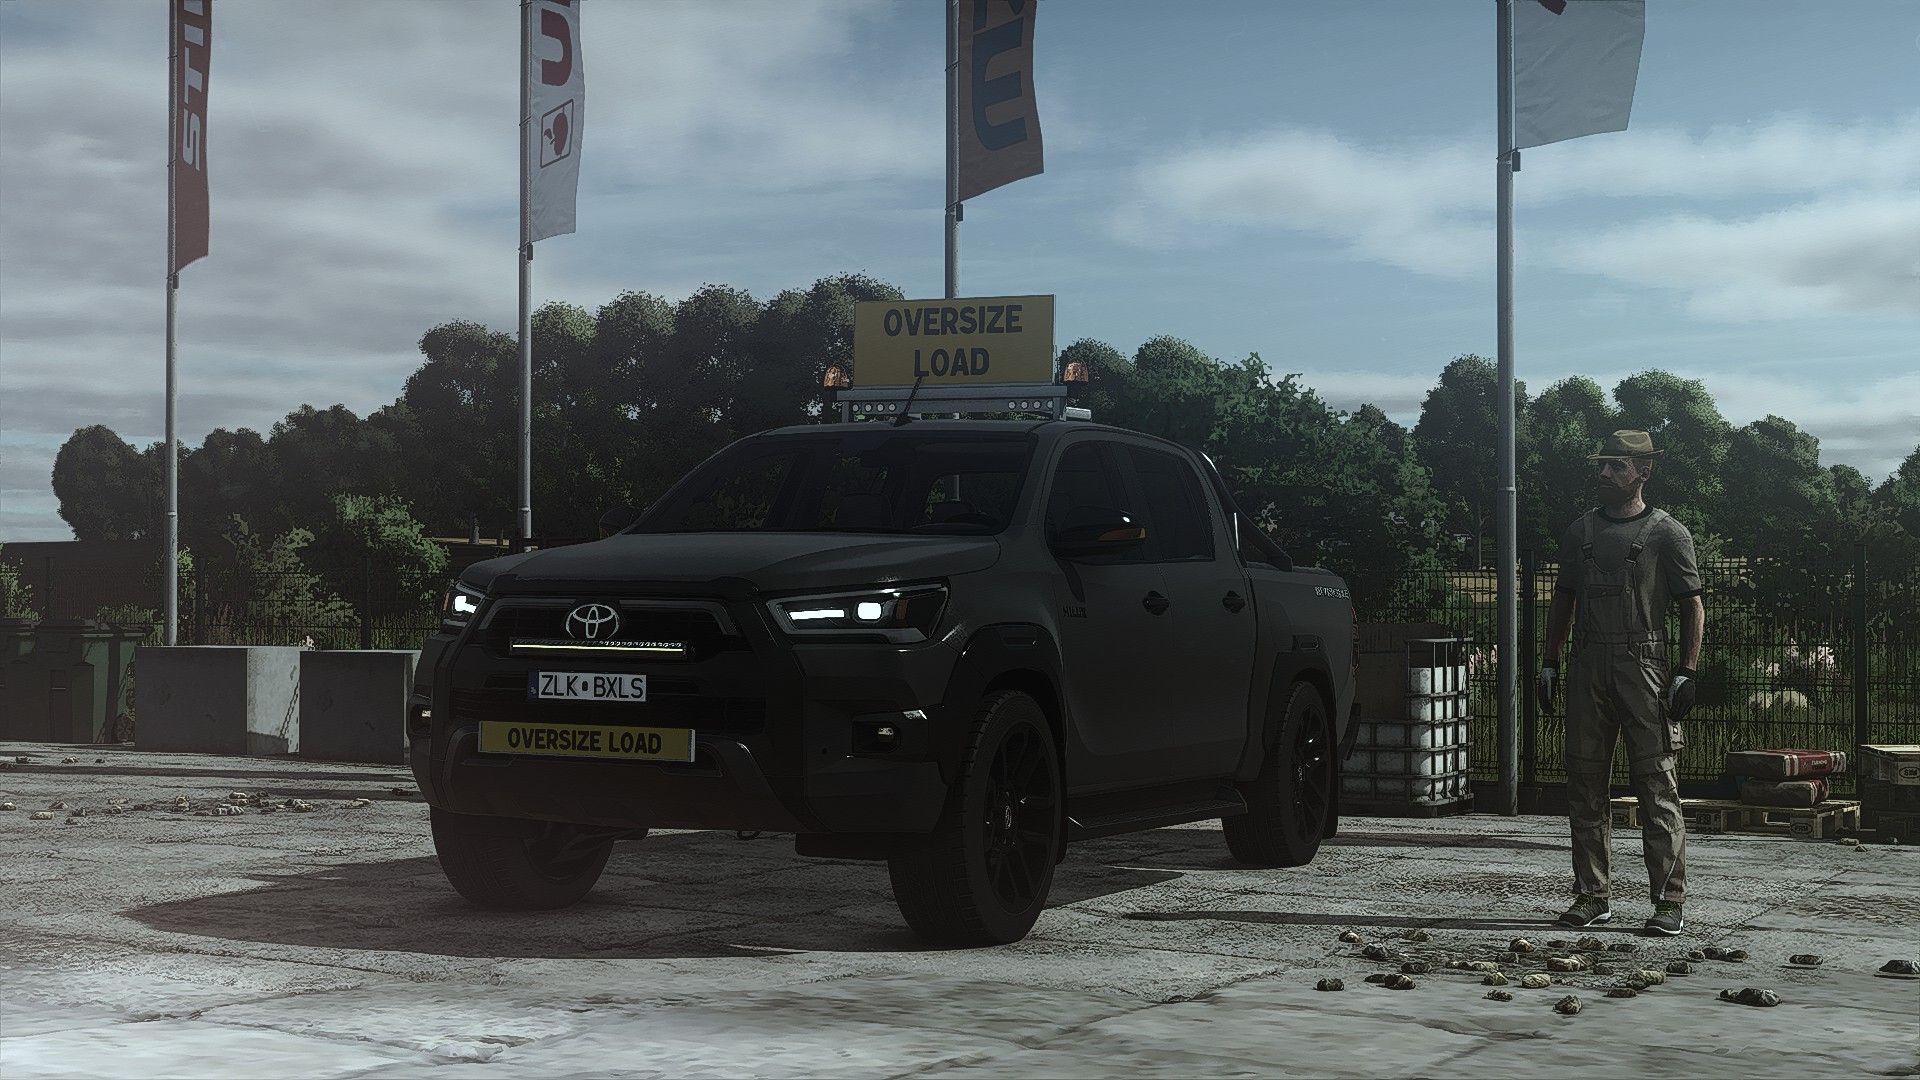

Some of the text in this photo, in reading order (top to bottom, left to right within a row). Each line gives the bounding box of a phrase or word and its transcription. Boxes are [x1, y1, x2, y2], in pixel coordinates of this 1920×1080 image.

[541, 0, 572, 86] U
[183, 0, 204, 171] STI
[884, 304, 1023, 337] OVERSIZE
[914, 347, 990, 377] LOAD
[541, 675, 644, 699] ZLK BXLS
[508, 727, 662, 754] OVERSIZE LOAD
